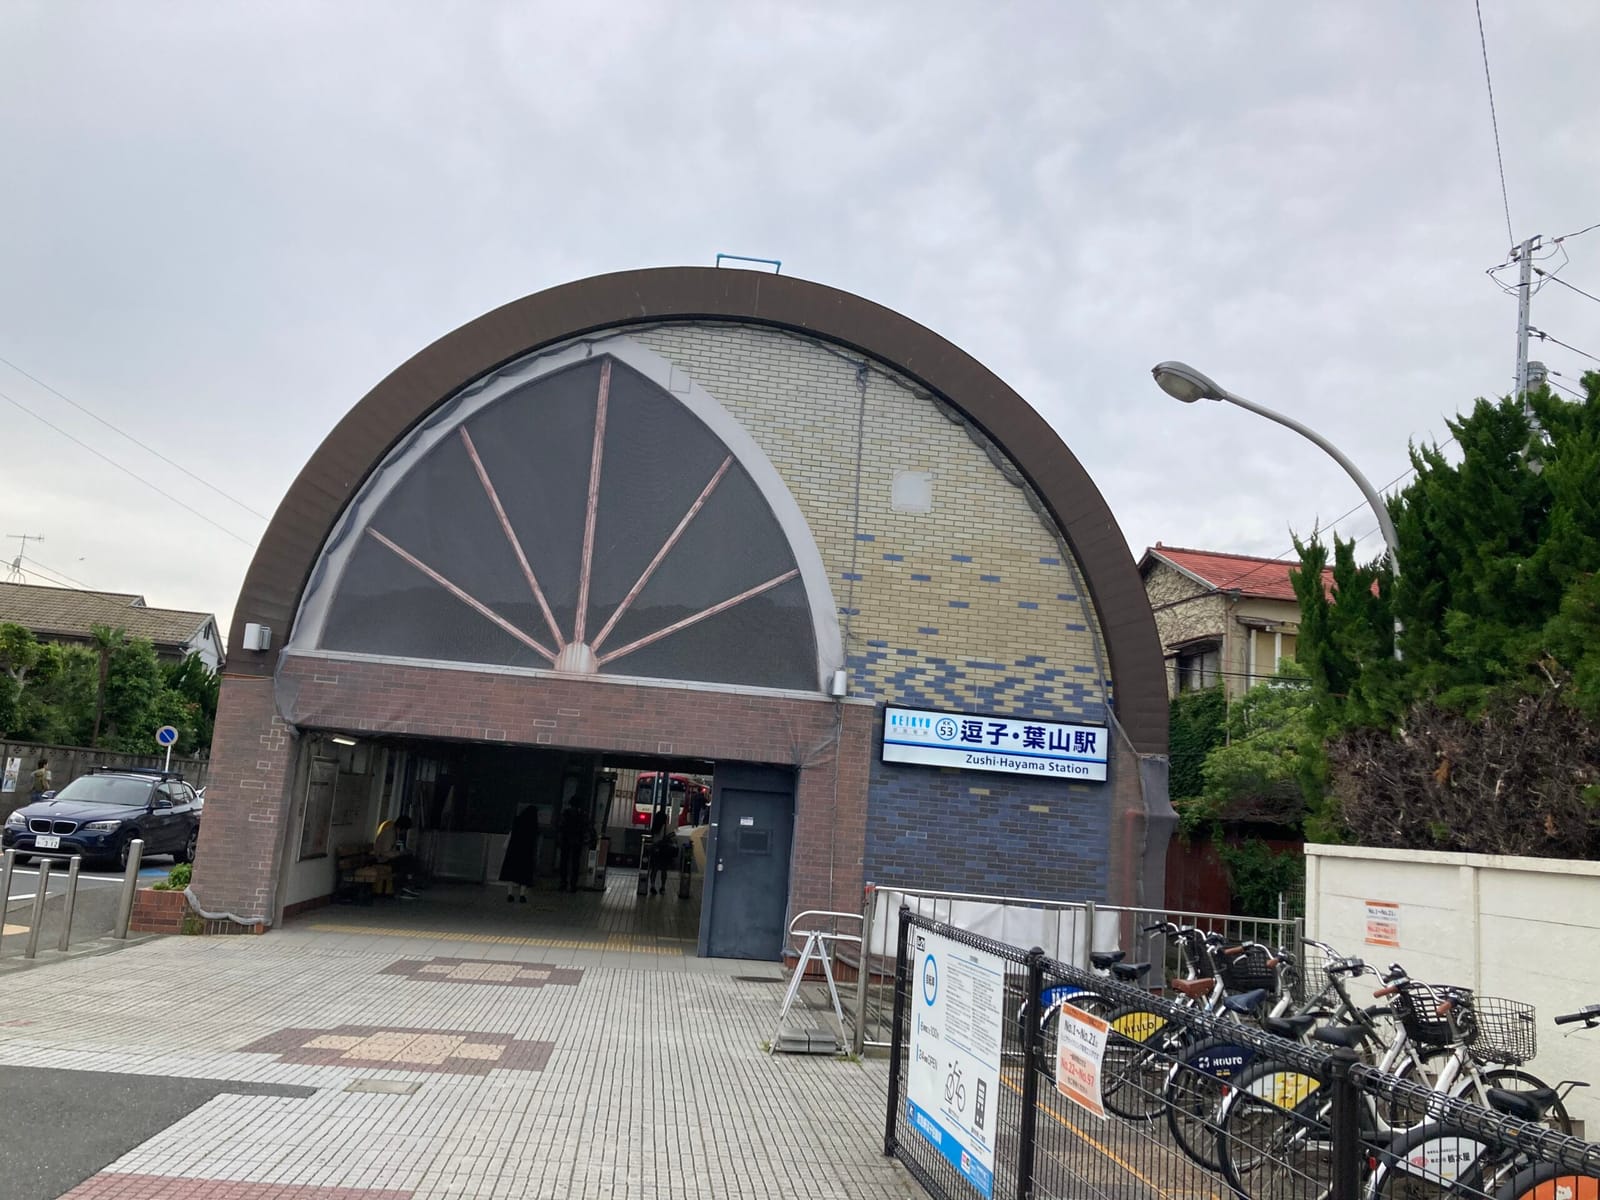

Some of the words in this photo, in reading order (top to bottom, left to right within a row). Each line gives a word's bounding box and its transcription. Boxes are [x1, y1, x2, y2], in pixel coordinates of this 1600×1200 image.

[891, 715, 930, 728] KEIKYU
[940, 726, 953, 737] 53
[960, 719, 1097, 755] 逗子・葉山駅
[1048, 761, 1089, 775] Station
